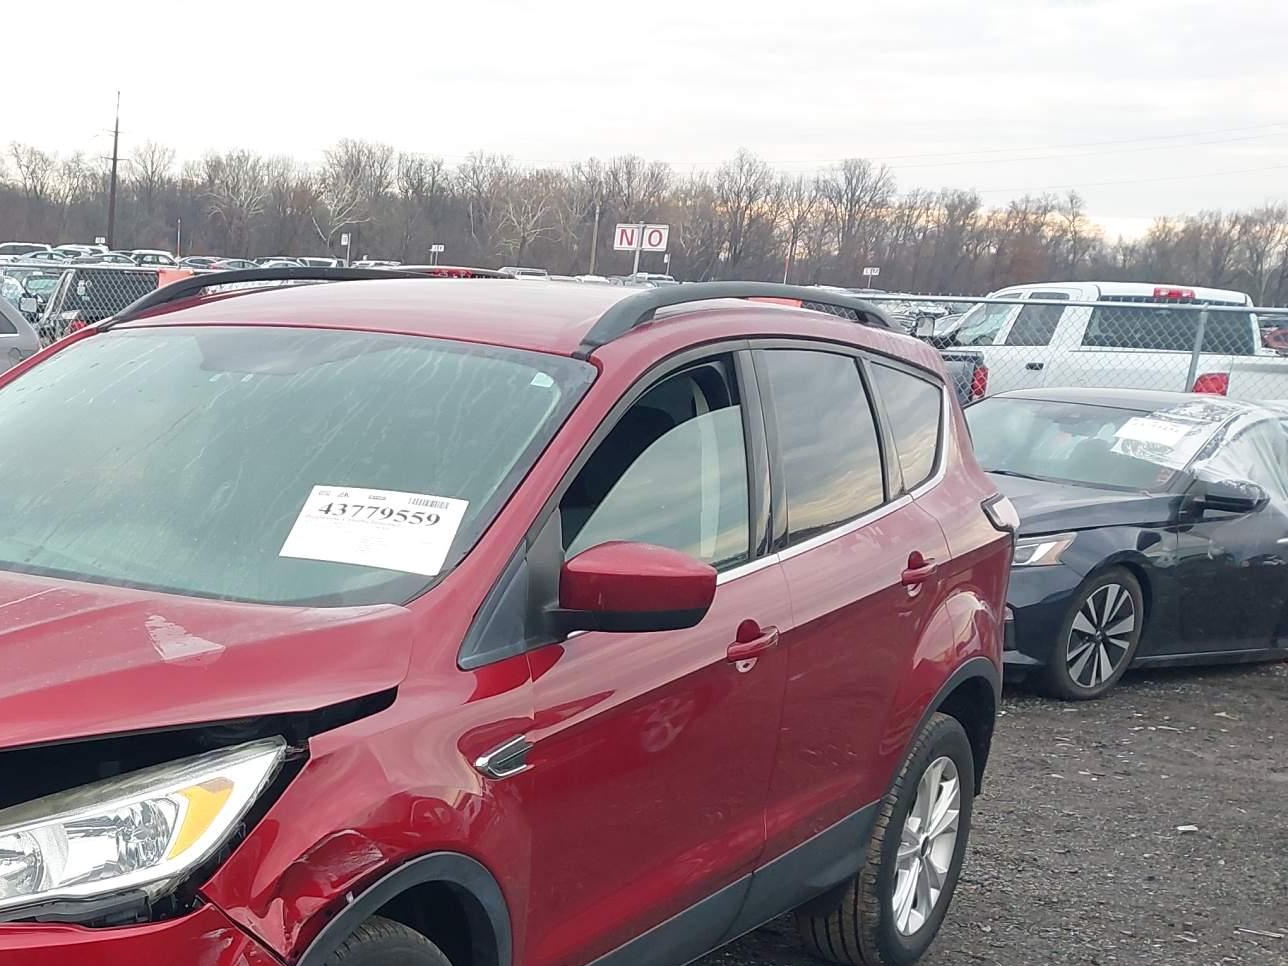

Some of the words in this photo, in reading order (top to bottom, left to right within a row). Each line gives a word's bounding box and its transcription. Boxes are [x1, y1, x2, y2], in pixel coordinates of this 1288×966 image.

[619, 229, 635, 246] N
[648, 229, 663, 247] O
[318, 502, 441, 526] 43779559
